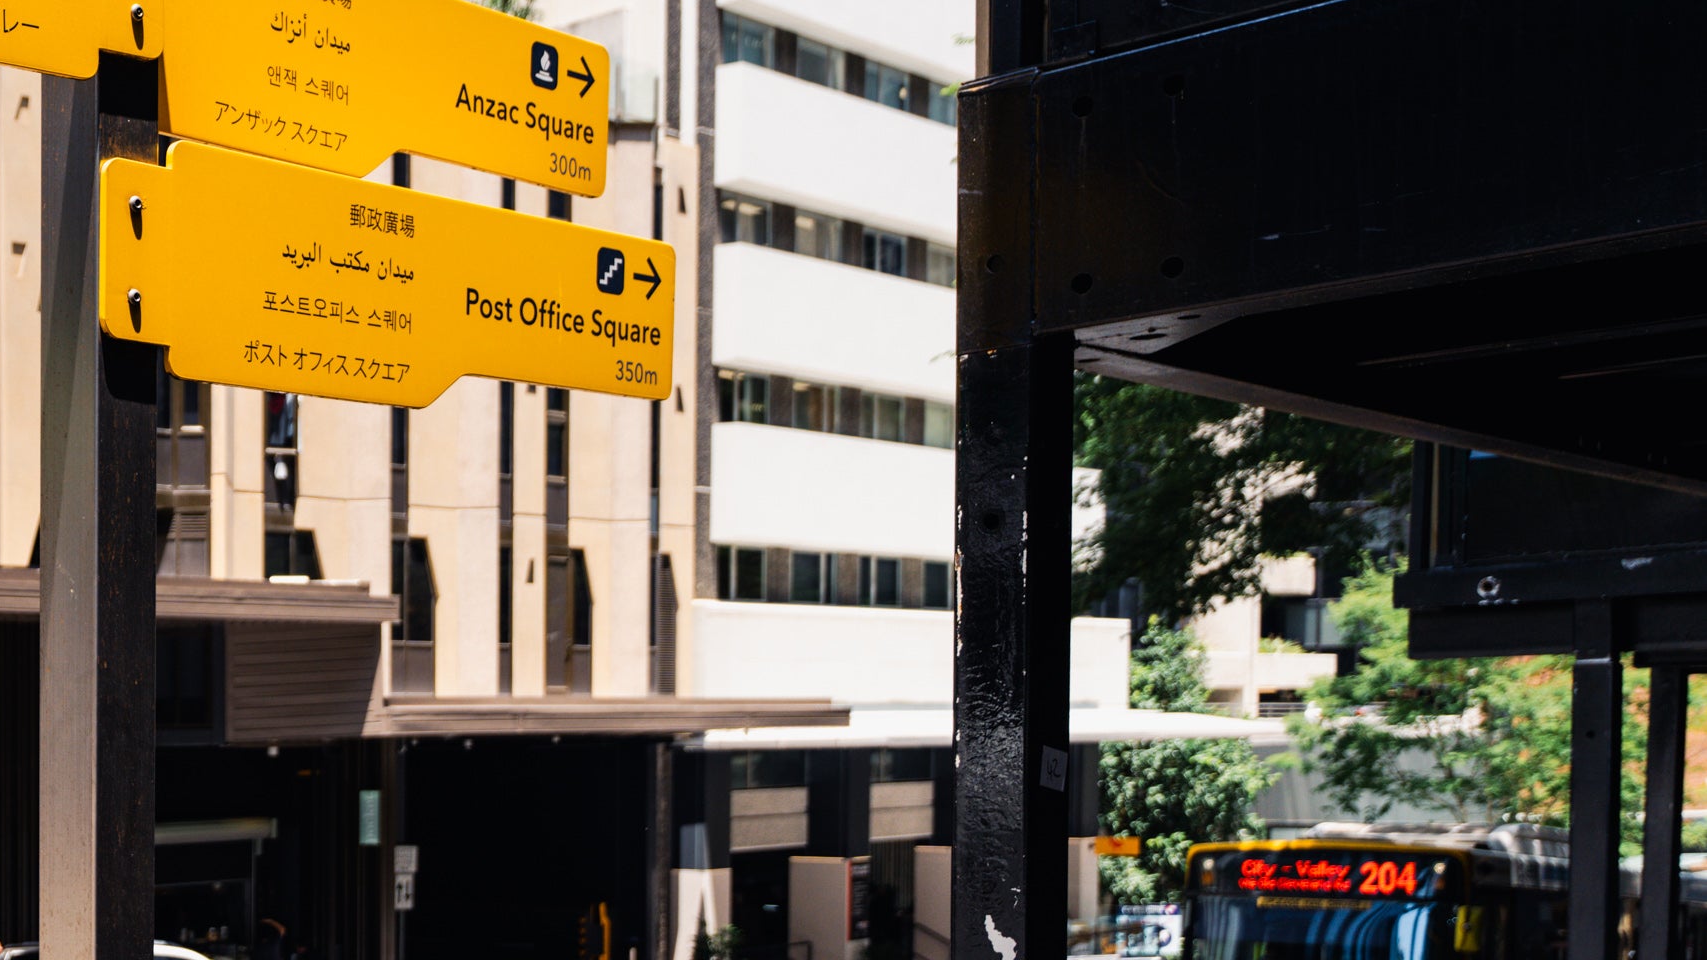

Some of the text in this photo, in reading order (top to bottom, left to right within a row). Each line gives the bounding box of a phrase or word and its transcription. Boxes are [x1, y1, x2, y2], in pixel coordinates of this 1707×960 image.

[271, 12, 350, 54] ميدان أنزاك
[268, 66, 348, 105] 앤잭 스퀘어
[215, 101, 347, 151] アンザック スクエア
[456, 84, 594, 144] Anzac Square
[550, 153, 590, 181] 300m
[350, 204, 414, 238] 郵政廣場
[283, 242, 413, 283] ميدان مكتب البريد
[263, 291, 411, 333] 포스트오피스 스퀘어
[467, 288, 660, 347] Post Office Square
[244, 340, 410, 383] ポスト オフィス スクエア
[616, 360, 657, 385] 350m
[1241, 859, 1278, 878] City
[1358, 861, 1418, 896] 204
